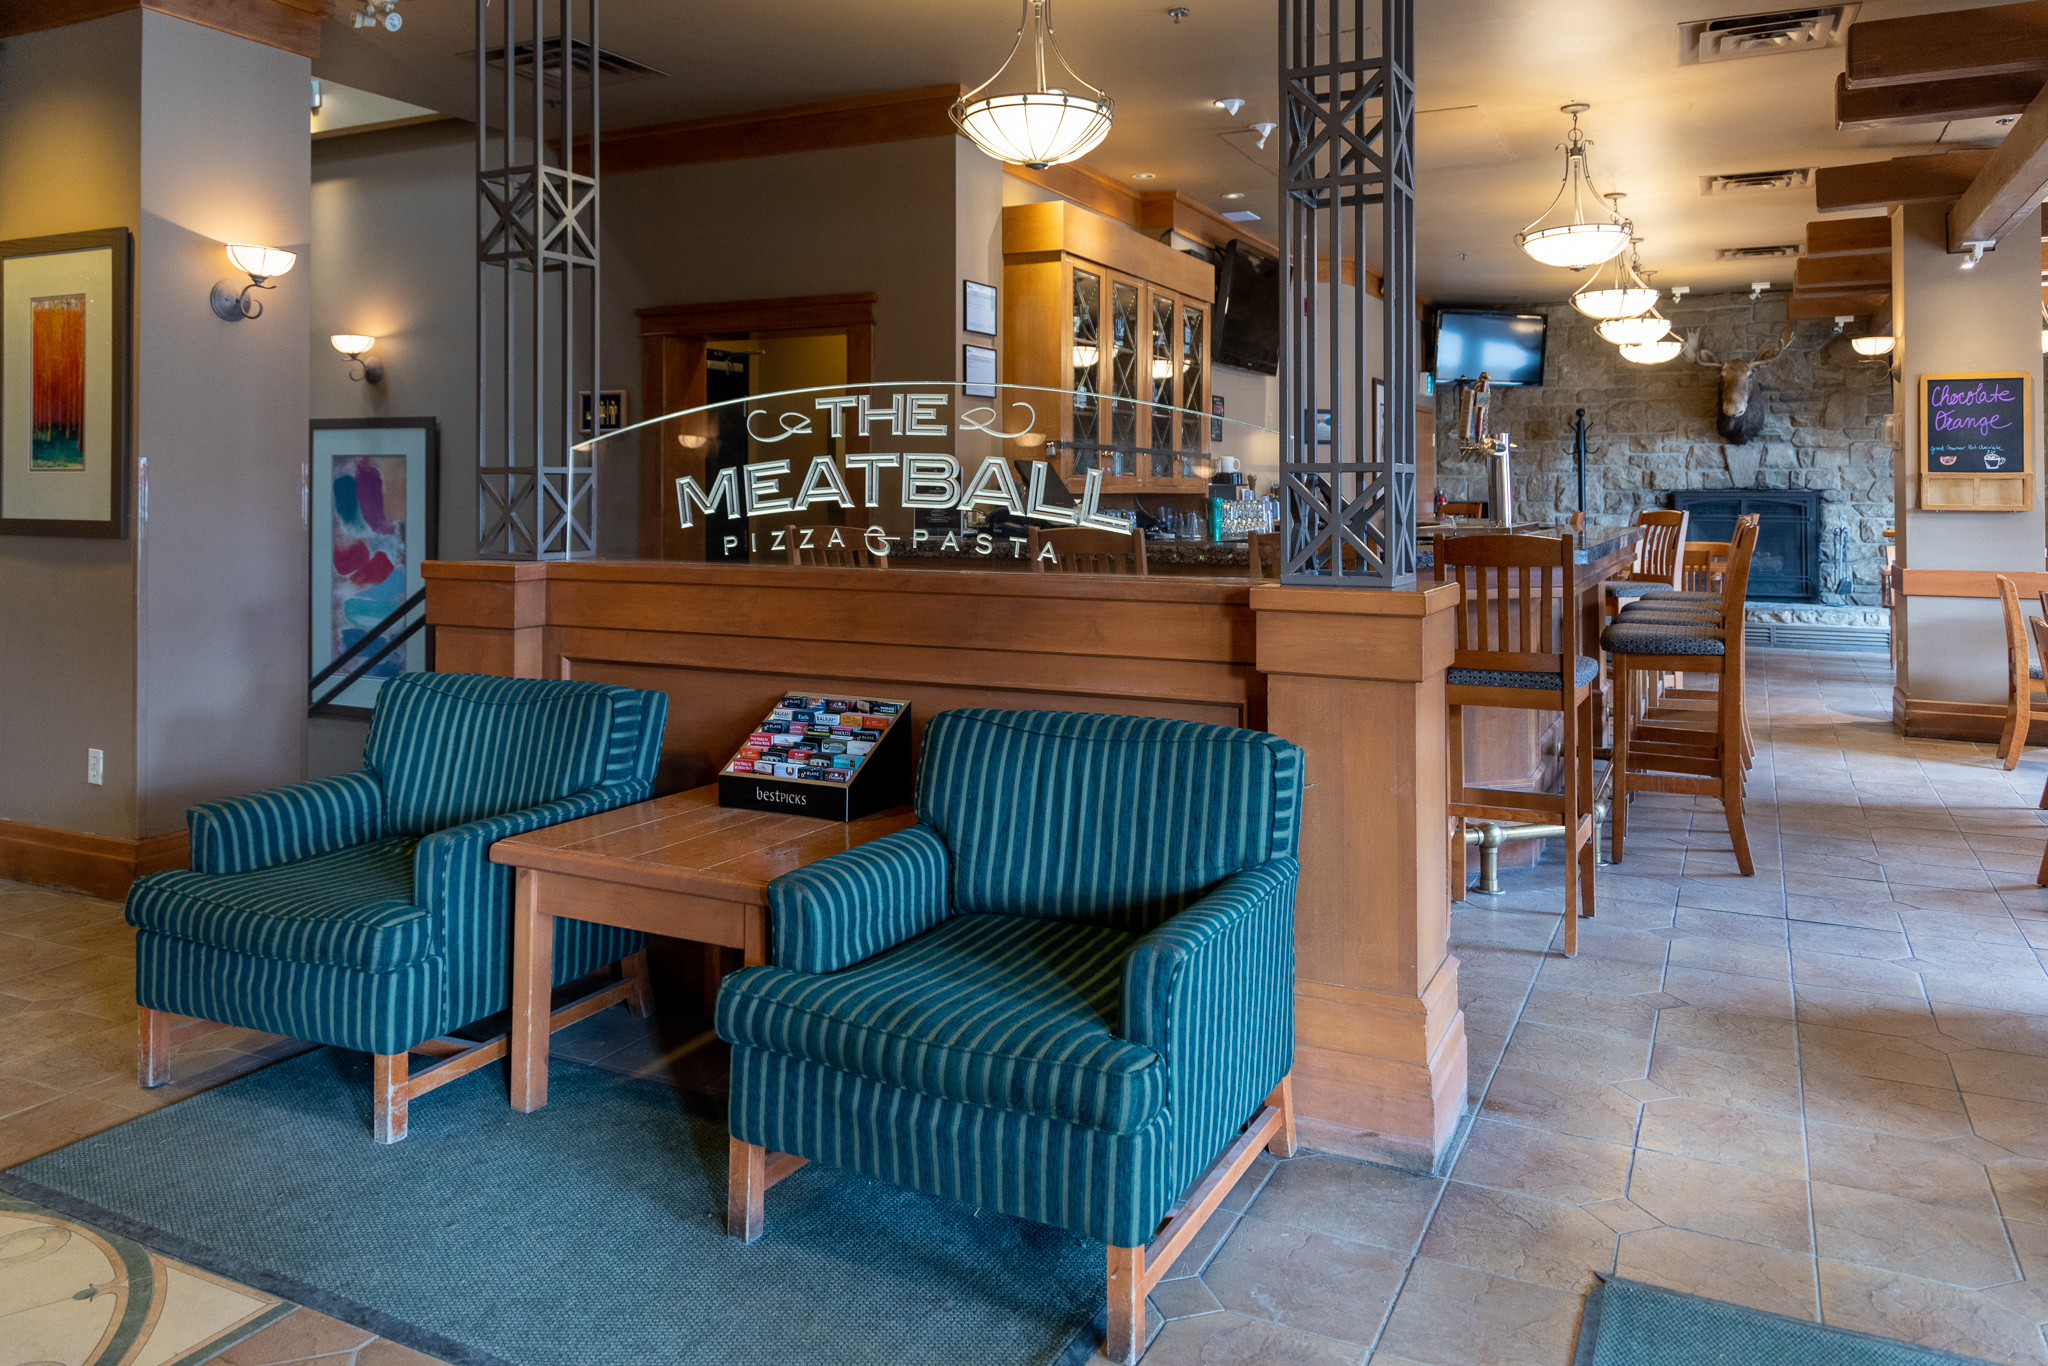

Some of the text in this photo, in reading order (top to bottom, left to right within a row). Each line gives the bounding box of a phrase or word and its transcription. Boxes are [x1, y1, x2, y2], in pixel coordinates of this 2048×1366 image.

[1931, 382, 2016, 407] Chocolate
[815, 393, 948, 438] THE
[1935, 409, 2013, 436] Orange
[675, 452, 1134, 535] MEATBALL
[723, 527, 846, 556] PIZZA
[912, 528, 1058, 564] PASTA
[756, 786, 807, 806] bestPICKS
